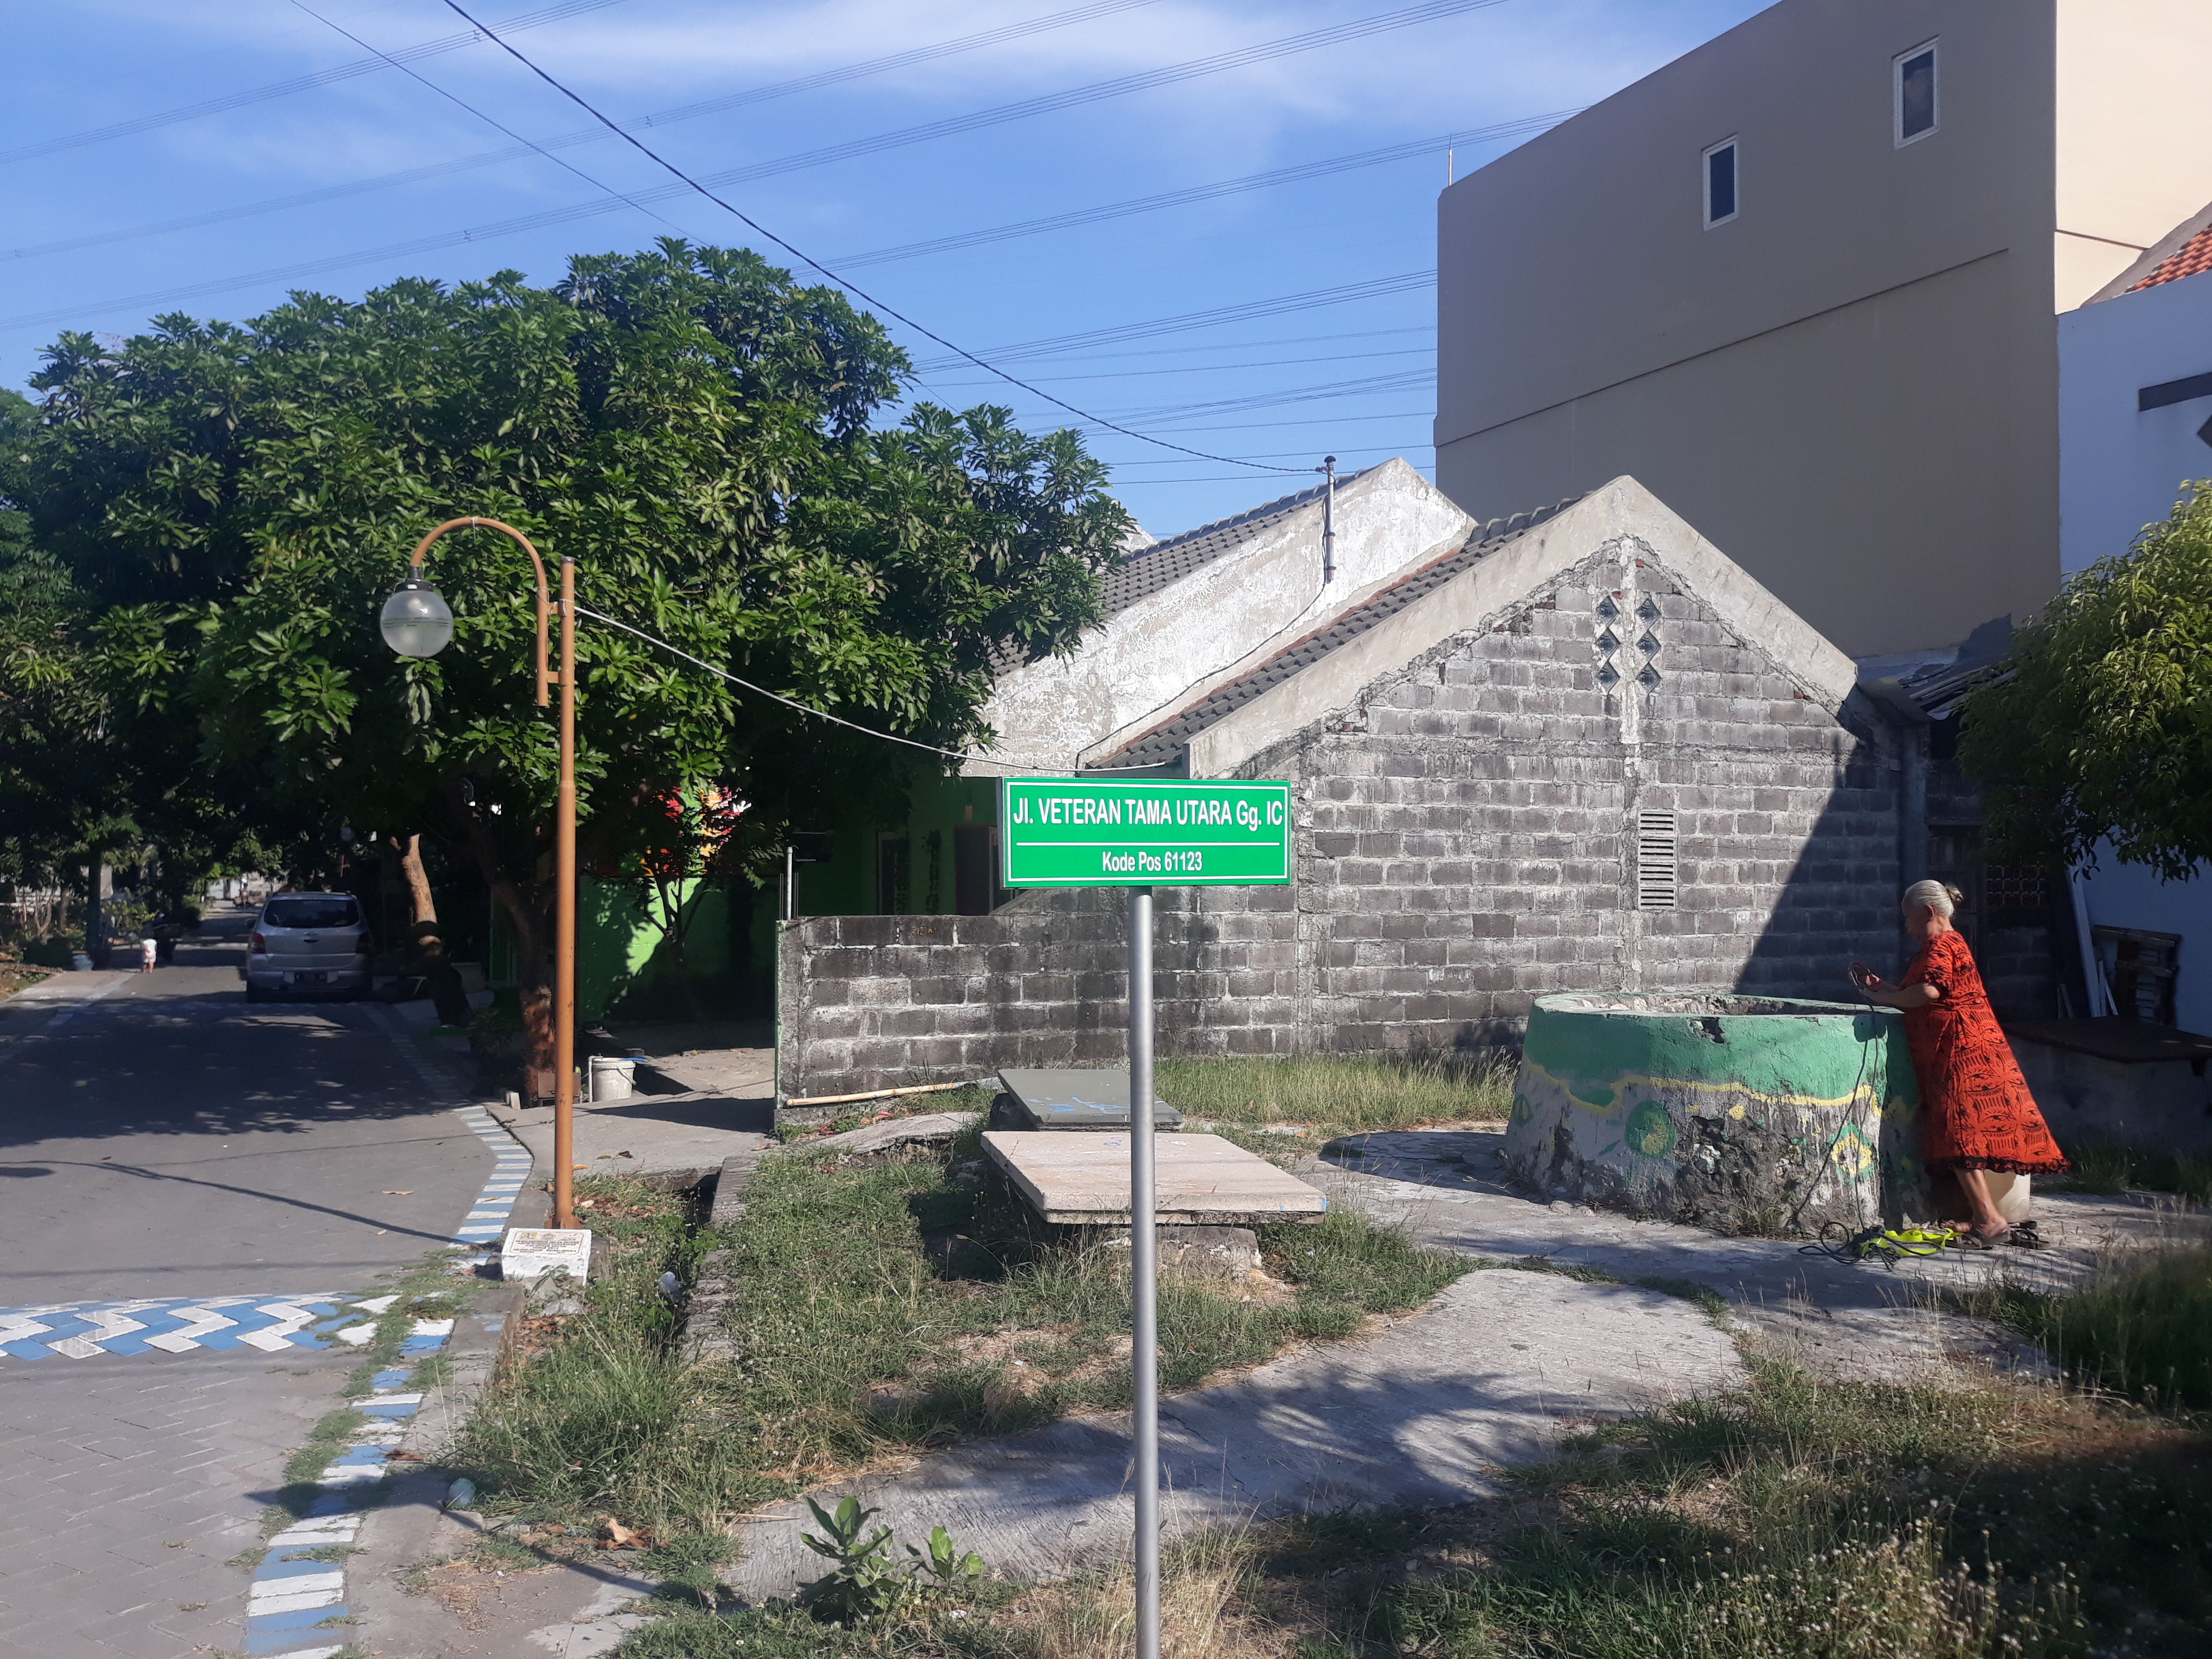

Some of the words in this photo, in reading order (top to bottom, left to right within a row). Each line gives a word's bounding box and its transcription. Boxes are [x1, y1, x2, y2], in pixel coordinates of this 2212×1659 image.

[1013, 797, 1034, 824] Jl.
[1038, 797, 1121, 825] VETERAN
[1125, 799, 1172, 825] TAMA
[1176, 799, 1232, 826] UTARA
[1236, 800, 1262, 832] Gg.
[1267, 801, 1283, 826] IC
[1102, 851, 1135, 872] Kode
[1139, 851, 1162, 872] Pos
[1164, 851, 1202, 872] 61123
